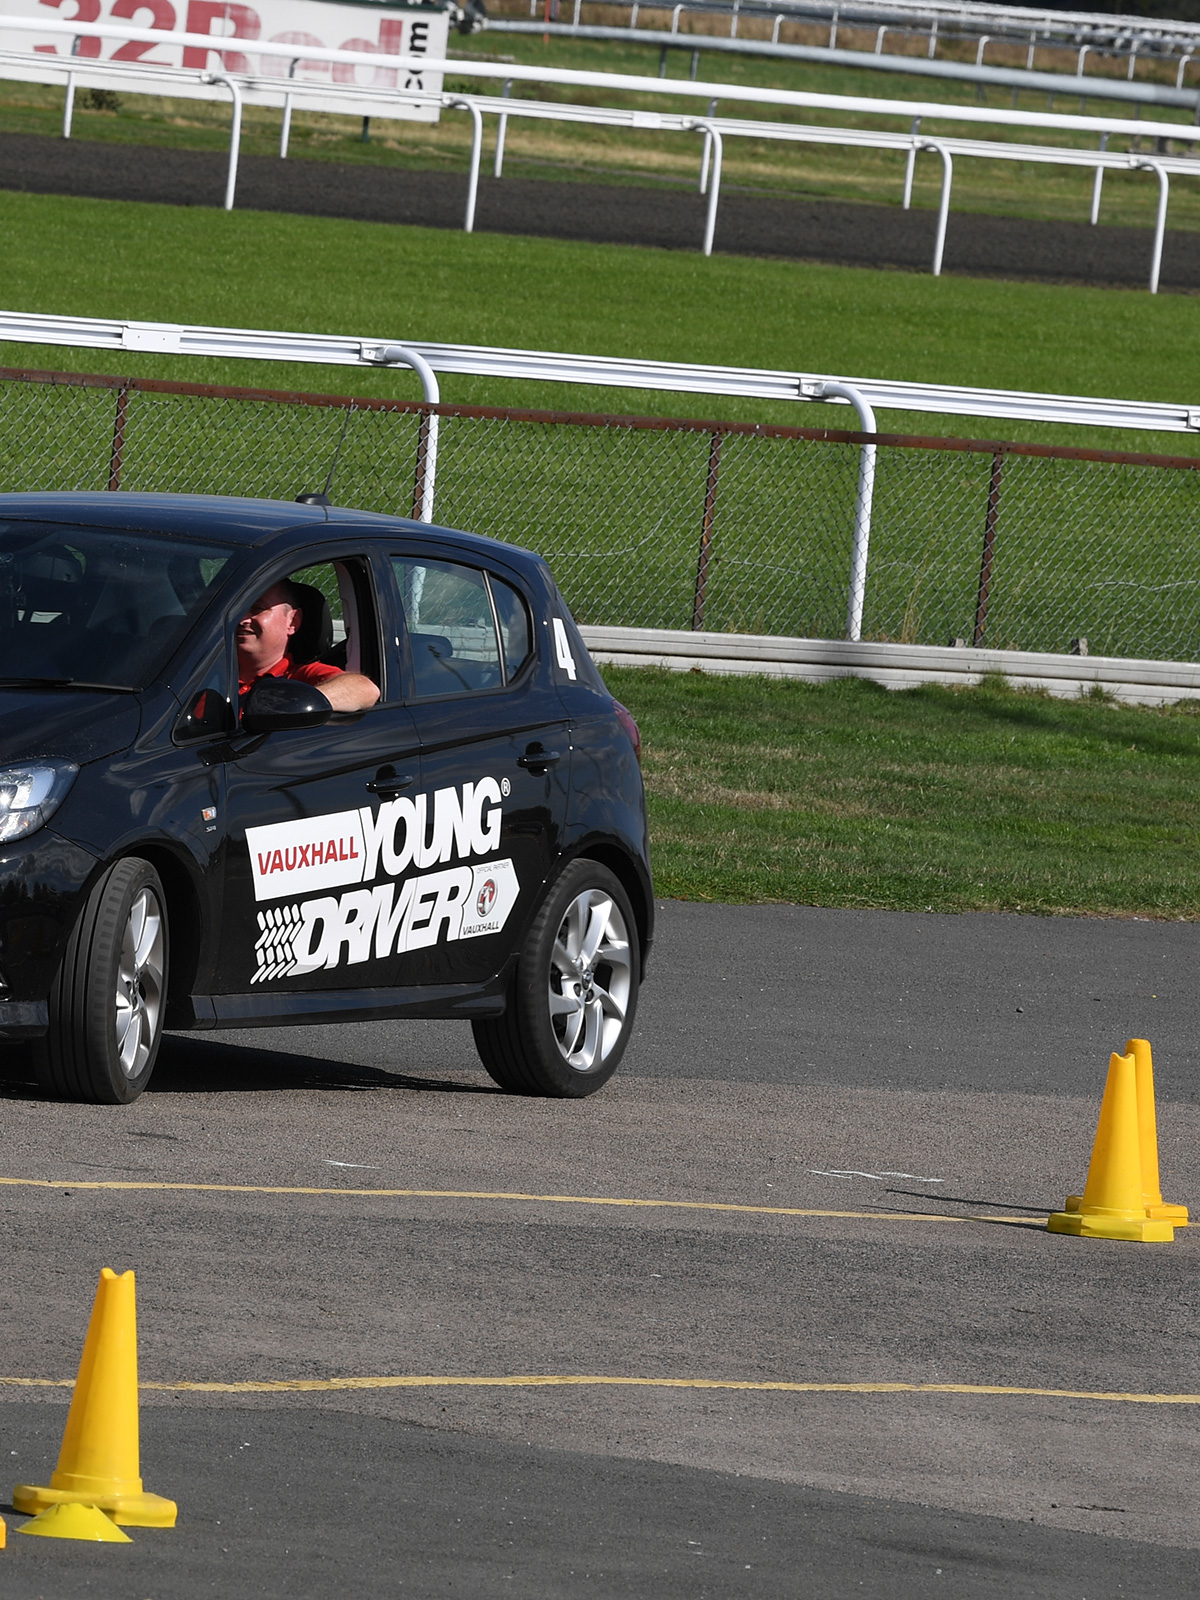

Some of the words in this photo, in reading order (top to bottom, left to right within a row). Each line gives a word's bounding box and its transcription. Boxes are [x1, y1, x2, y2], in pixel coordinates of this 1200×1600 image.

[552, 617, 577, 680] 4
[257, 836, 359, 876] VAUXHALL
[359, 776, 502, 882] YOUNG
[286, 865, 474, 977] DRIVER
[462, 920, 500, 936] VAUXHALL
